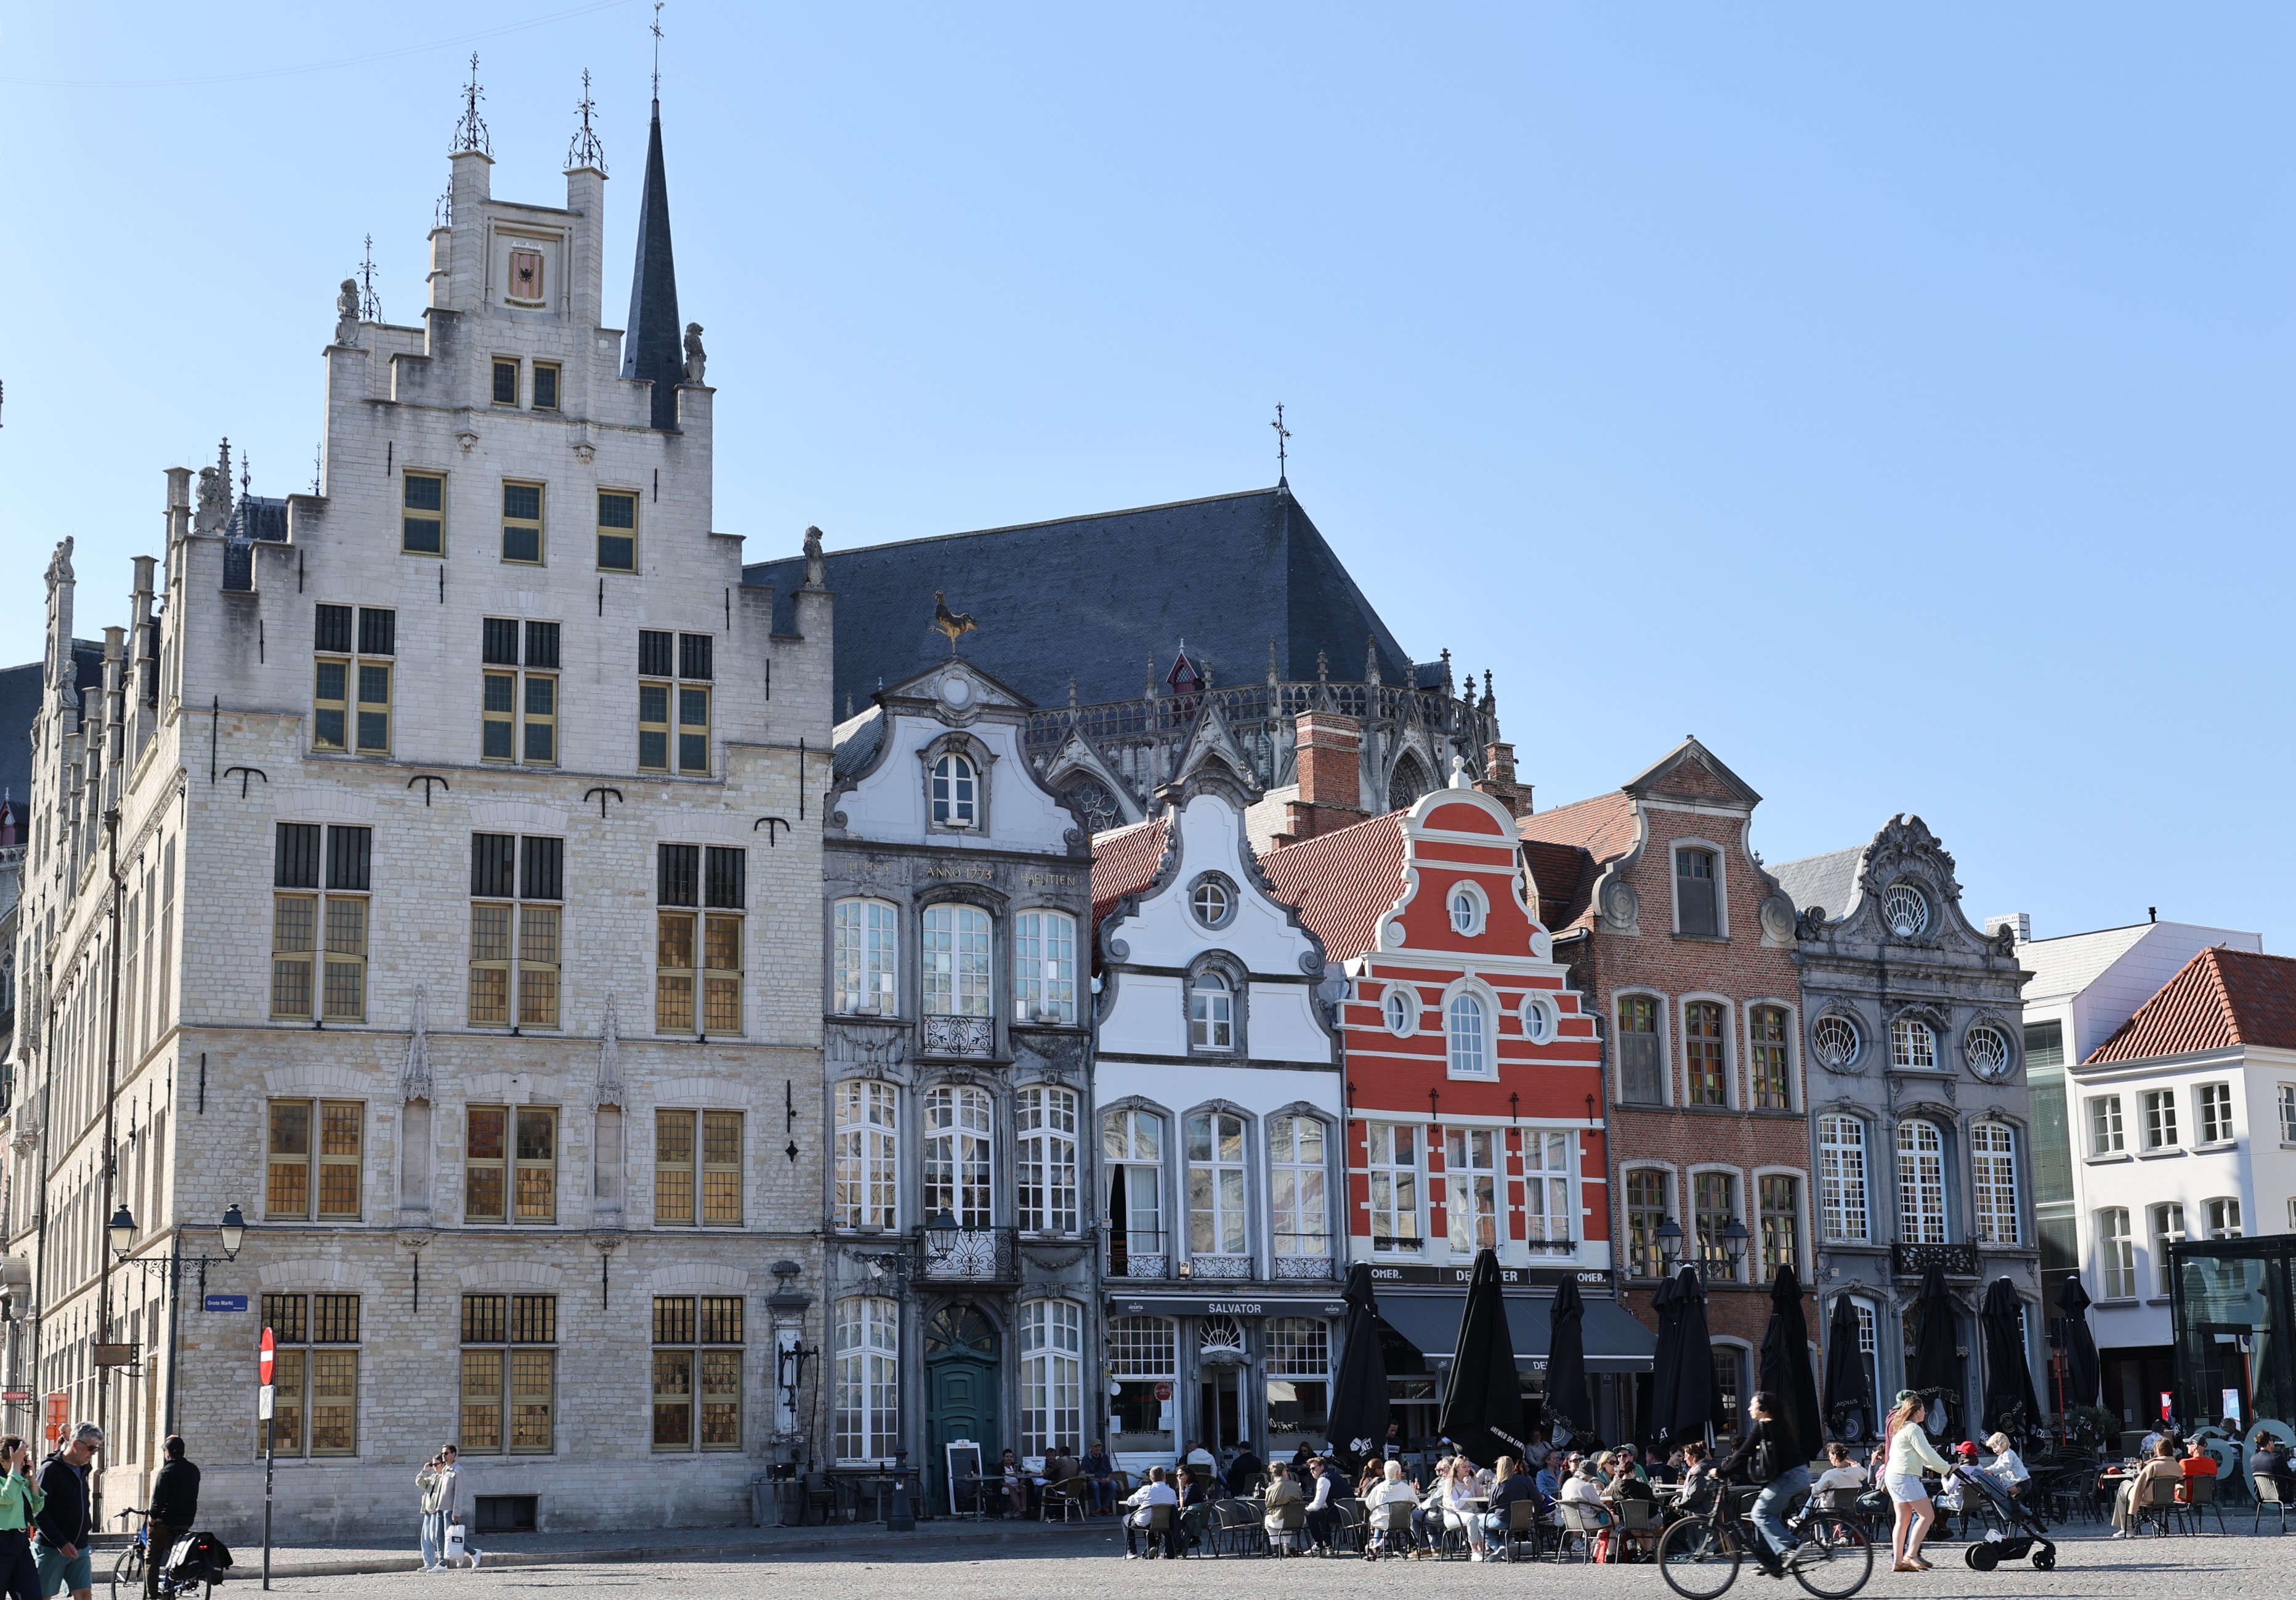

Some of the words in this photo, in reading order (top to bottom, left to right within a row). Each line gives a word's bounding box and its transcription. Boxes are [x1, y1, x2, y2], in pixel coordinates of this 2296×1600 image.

[844, 860, 857, 870] IN
[864, 862, 891, 872] HET
[927, 867, 961, 878] ANNO
[966, 868, 992, 880] 1773
[1021, 872, 1075, 886] HAENTIEN
[1371, 1269, 1402, 1279] OMER.
[1456, 1270, 1471, 1281] DE
[1500, 1271, 1518, 1282] ER
[1577, 1272, 1606, 1282] OMER.
[1208, 1304, 1261, 1314] SALVATOR
[1533, 1362, 1548, 1370] DE
[1916, 1386, 1942, 1396] AROLUS
[1506, 1436, 1514, 1444] ON
